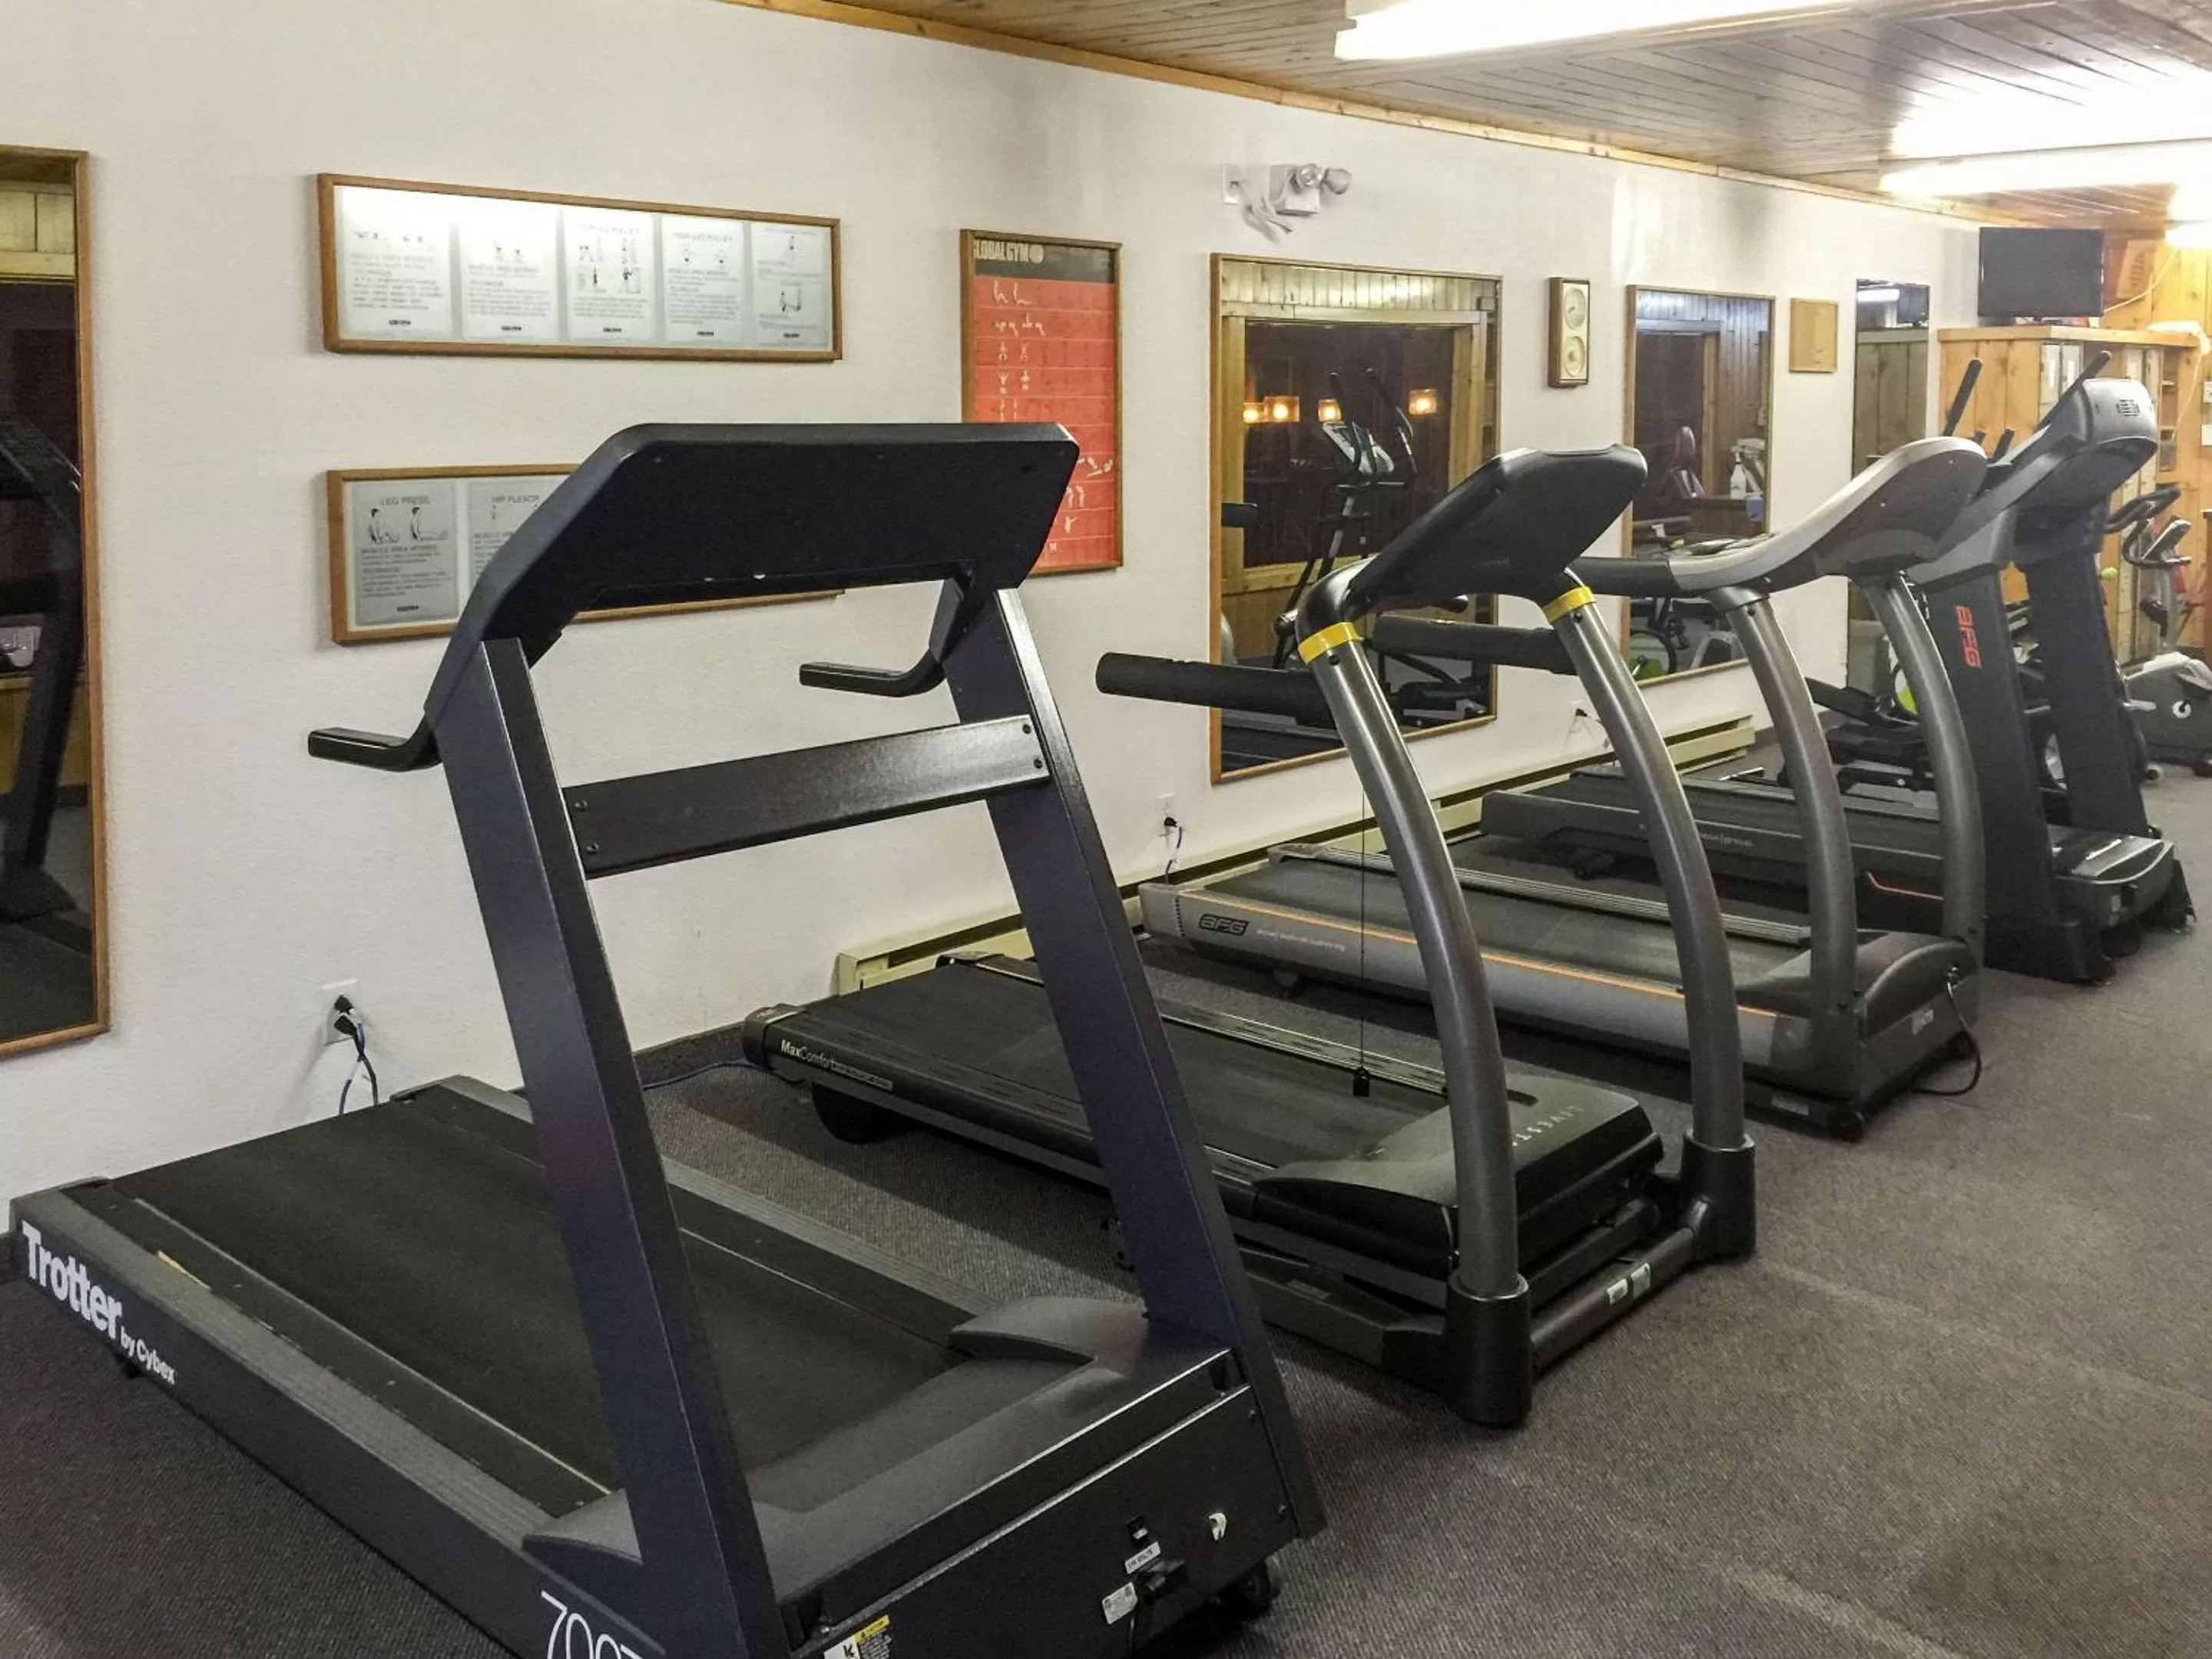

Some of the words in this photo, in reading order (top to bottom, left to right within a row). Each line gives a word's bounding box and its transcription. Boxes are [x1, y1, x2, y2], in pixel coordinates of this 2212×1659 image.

[381, 497, 399, 505] LEG
[22, 1219, 123, 1339] Trotter
[121, 1326, 135, 1357] by
[137, 1339, 177, 1385] Cybex
